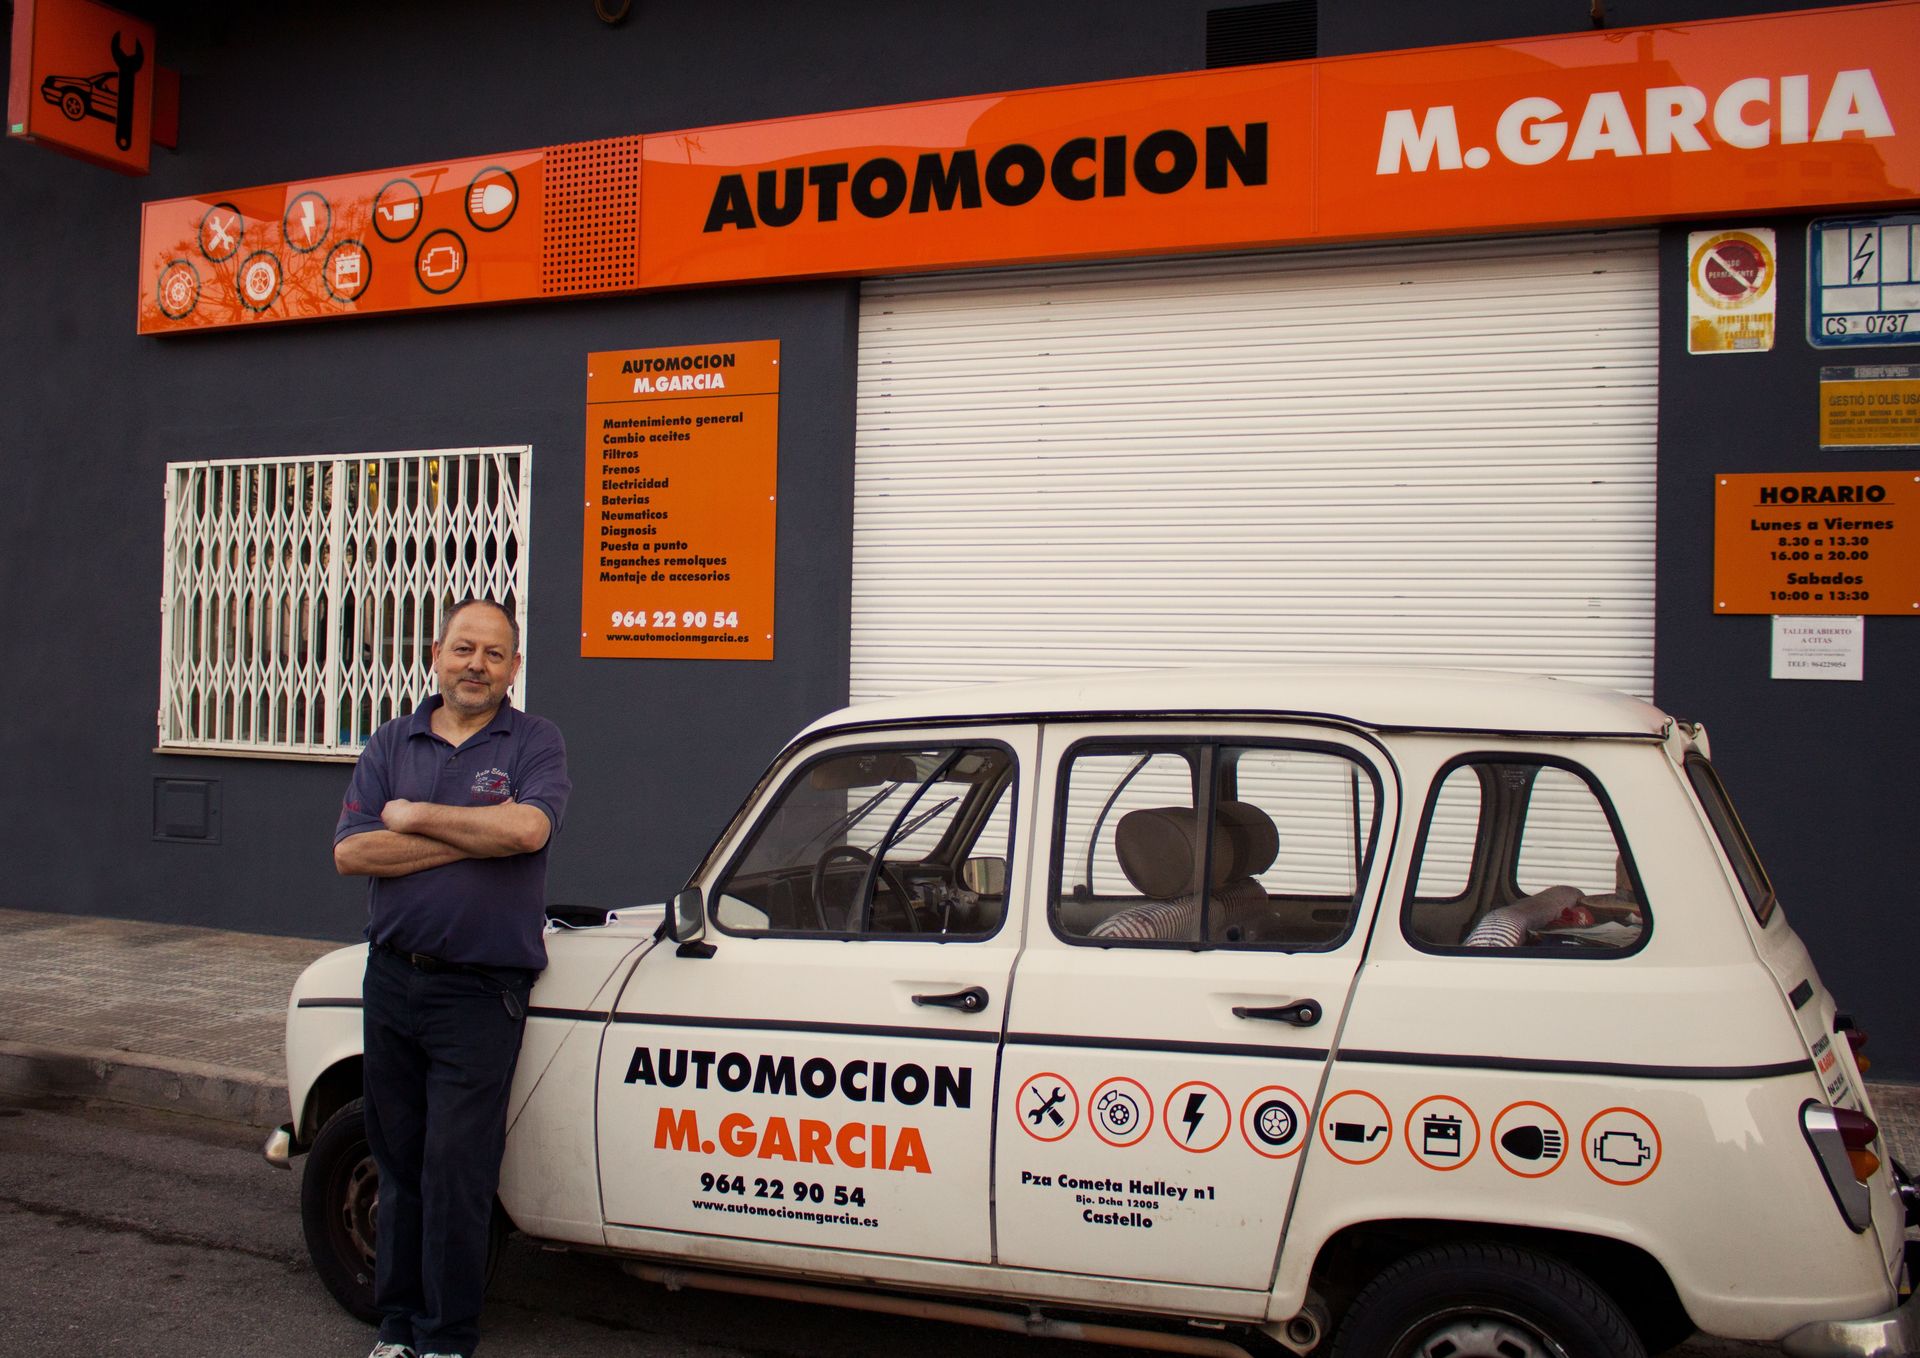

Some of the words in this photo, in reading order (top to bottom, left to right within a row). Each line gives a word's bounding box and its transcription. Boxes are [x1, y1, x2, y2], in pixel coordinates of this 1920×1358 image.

[703, 122, 1268, 233] AUTOMOCION
[1376, 69, 1895, 175] M.GARCIA
[1826, 317, 1847, 335] CS
[1866, 314, 1908, 333] 0737
[621, 353, 735, 374] AUTOMOCION
[633, 373, 725, 393] M.GARCIA
[603, 415, 692, 429] Mantenimiento
[696, 412, 744, 427] general
[603, 432, 645, 444] Cambio
[649, 431, 691, 442] aceites
[602, 449, 639, 459] Filtros
[602, 465, 640, 475] Frenos
[602, 477, 669, 490] Electricidad
[601, 494, 650, 505] Baterias
[1760, 485, 1886, 504] HORARIO
[601, 509, 668, 520] Neumaticos
[1751, 519, 1801, 531] Lunes
[1807, 522, 1818, 530] a
[1825, 517, 1894, 530] Viernes
[601, 525, 657, 538] Diagnosis
[600, 541, 639, 551] Puesta
[653, 540, 688, 553] punto
[1778, 537, 1810, 547] 8.30
[1814, 539, 1823, 547] a
[1829, 537, 1869, 547] 13.30
[600, 556, 660, 568] Enganches
[664, 555, 727, 568] remolques
[1770, 551, 1810, 561] 16.00
[1814, 553, 1823, 561] a
[1828, 551, 1869, 561] 20.00
[600, 571, 647, 584] Montaje
[651, 571, 665, 582] de
[669, 570, 731, 582] accesorios
[1787, 573, 1864, 585] Sabados
[1770, 591, 1810, 601] 10:00
[1814, 593, 1823, 601] a
[1829, 591, 1869, 601] 13:30
[611, 611, 646, 627] 964
[652, 612, 676, 627] 22
[682, 611, 707, 628] 90
[712, 612, 738, 628] 54
[606, 632, 749, 644] www.automocionmgarcia.es
[624, 1046, 973, 1109] AUTOMOCION
[654, 1107, 932, 1174] M.GARCIA
[700, 1172, 746, 1196] 964
[754, 1178, 784, 1200] 22
[793, 1182, 824, 1204] 90
[834, 1185, 866, 1208] 54
[1021, 1171, 1052, 1187] Pza
[1058, 1174, 1123, 1194] Cometa
[1129, 1180, 1188, 1201] Halley
[1193, 1186, 1216, 1200] n1
[1076, 1195, 1095, 1206] Bjo.
[1098, 1196, 1123, 1207] Dcha
[1127, 1198, 1159, 1210] 12005
[692, 1200, 879, 1228] www.automocionmgarcia.es
[1083, 1209, 1153, 1229] Castello
